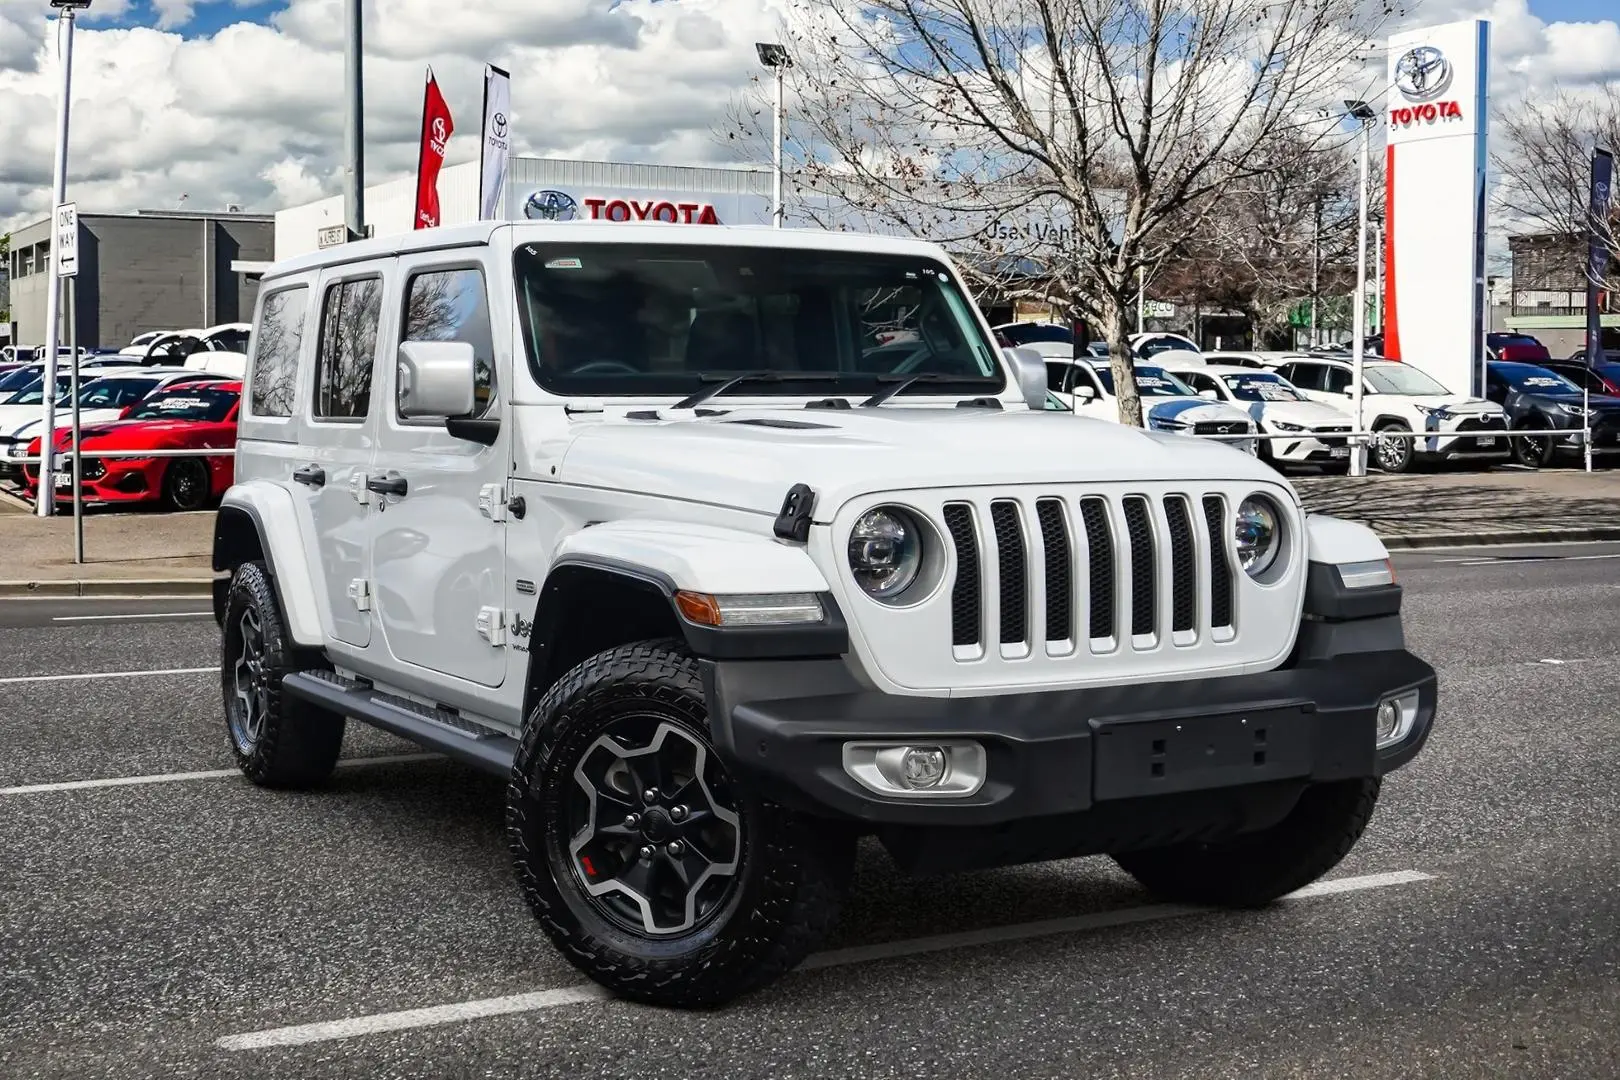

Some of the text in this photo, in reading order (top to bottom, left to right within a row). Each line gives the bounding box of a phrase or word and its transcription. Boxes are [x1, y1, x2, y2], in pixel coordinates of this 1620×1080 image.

[1390, 101, 1462, 124] TOYOTA
[488, 136, 508, 150] TOYOTA
[60, 210, 74, 227] ONE
[584, 198, 719, 225] TOYOTA
[60, 231, 75, 249] WAY
